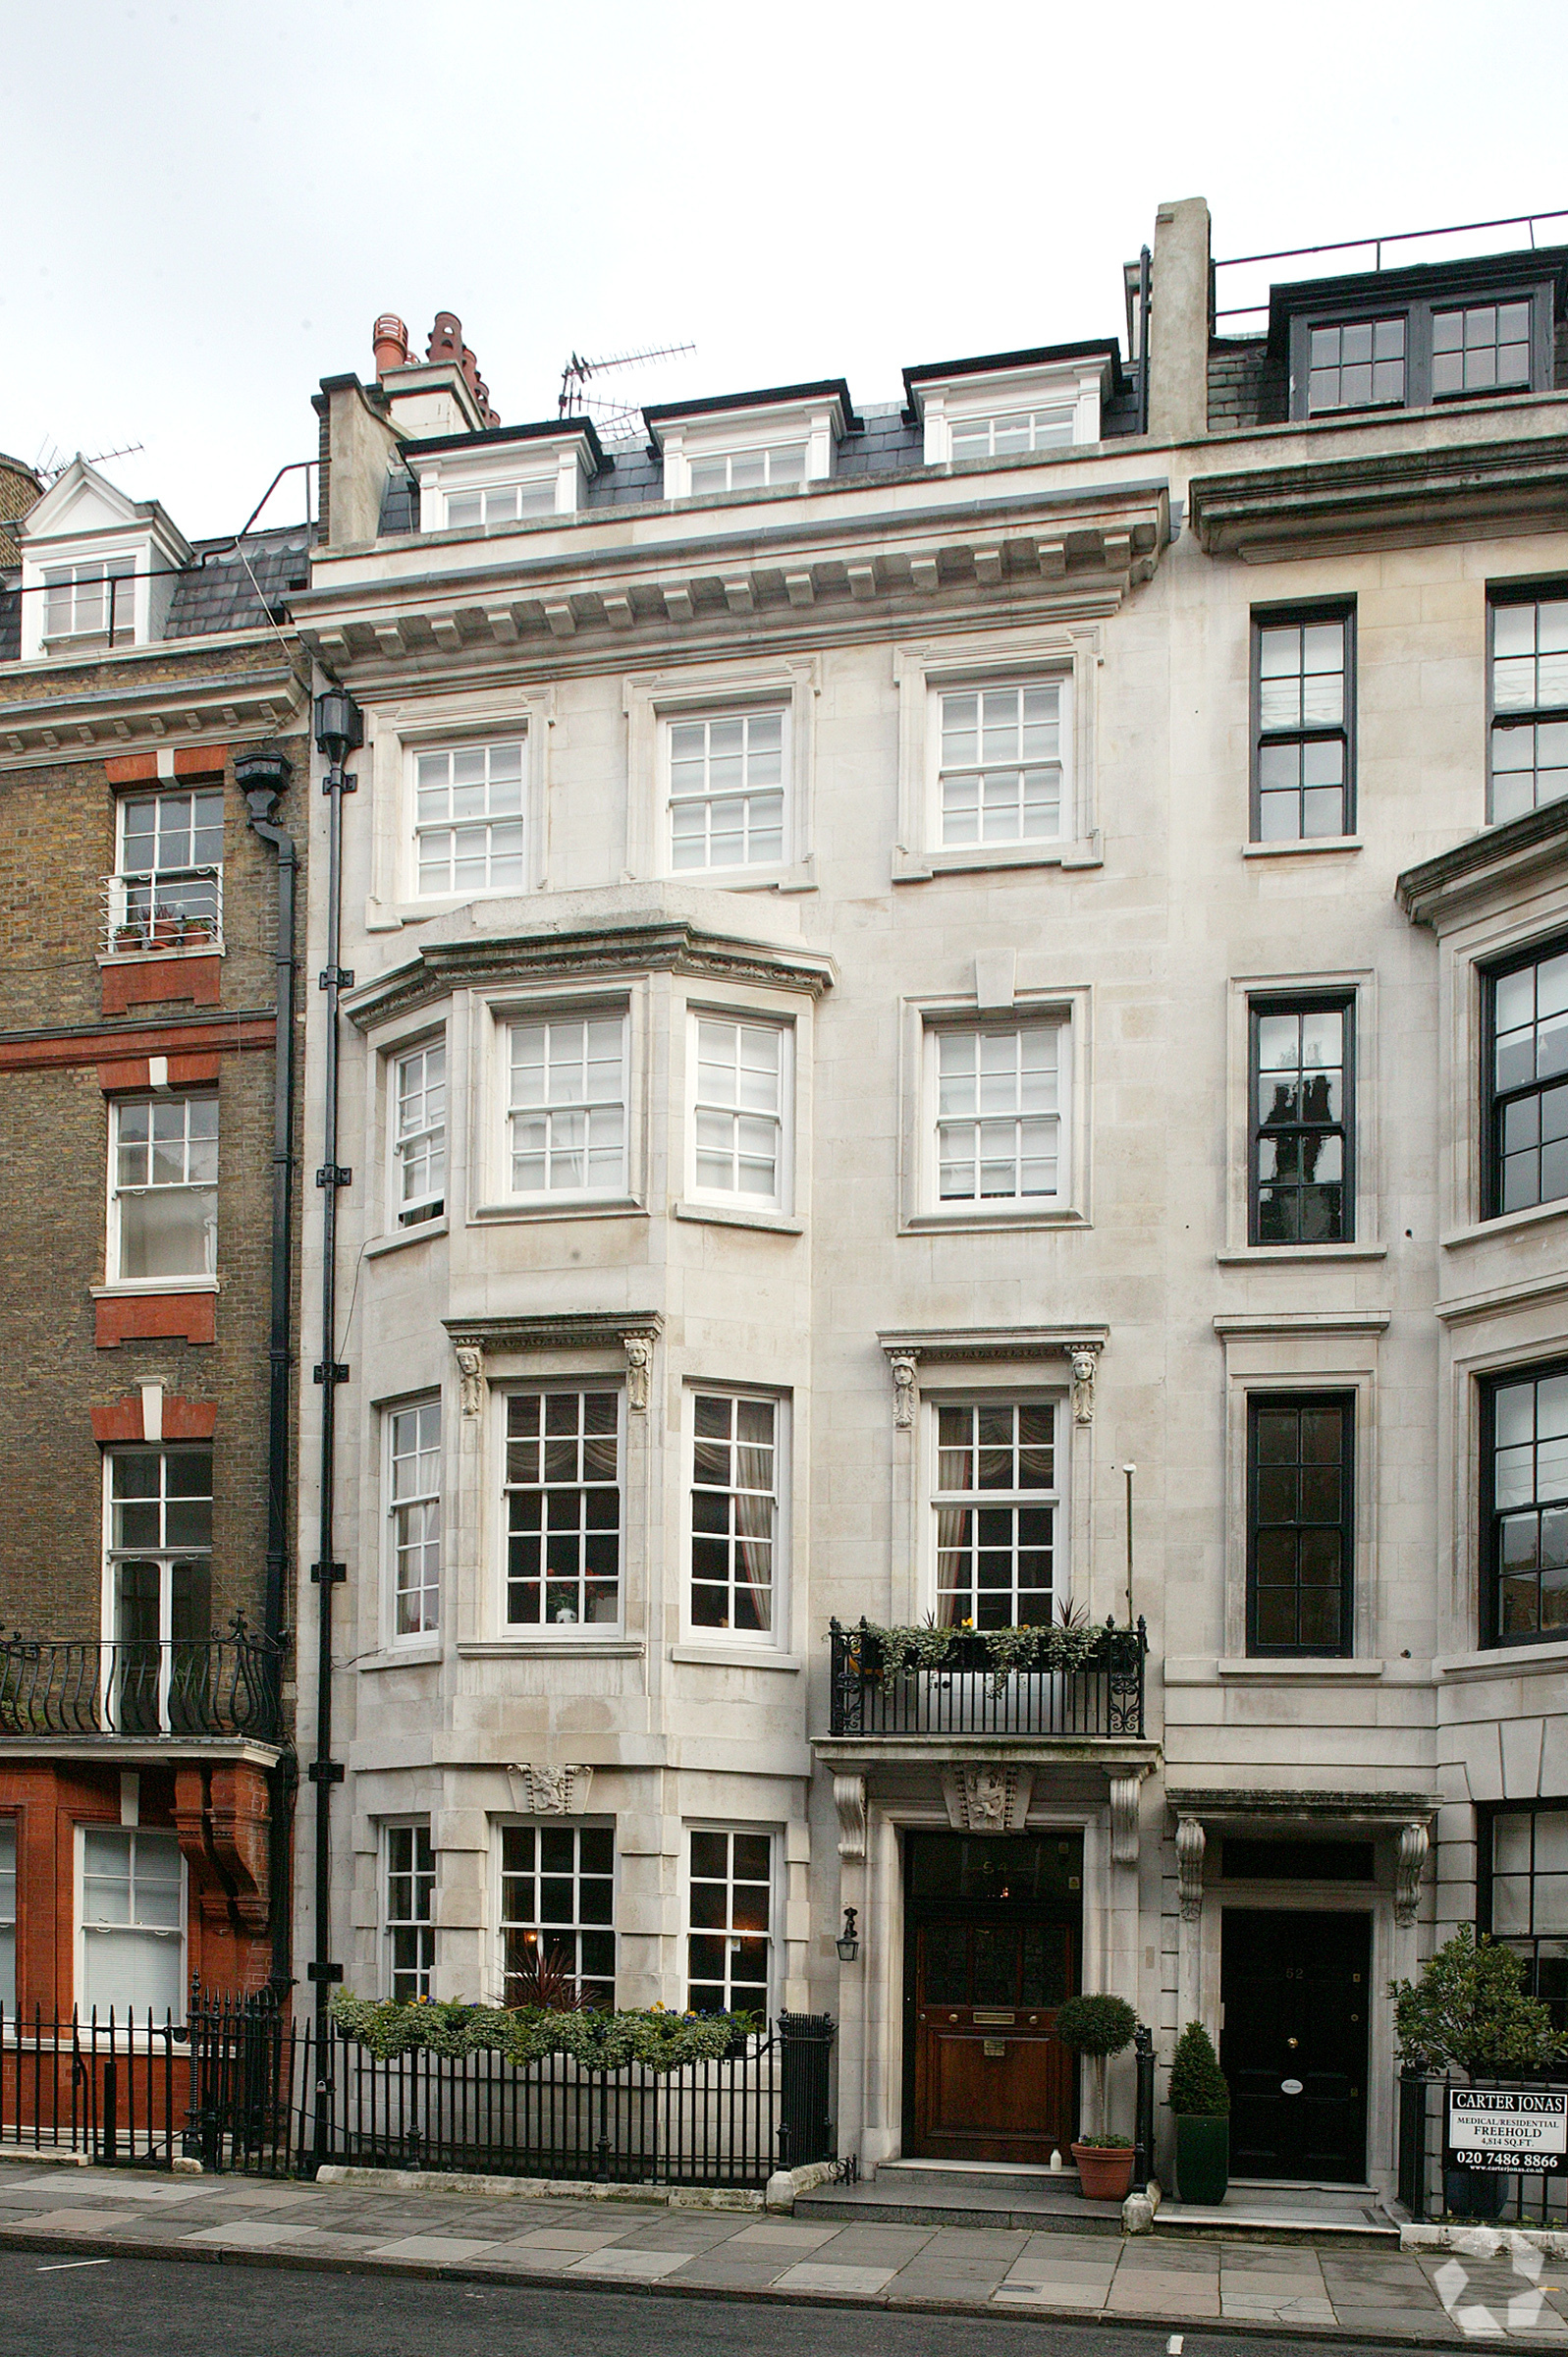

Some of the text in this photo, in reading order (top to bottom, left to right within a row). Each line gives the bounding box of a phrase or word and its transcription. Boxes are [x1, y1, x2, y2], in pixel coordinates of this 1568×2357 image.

[1457, 2094, 1563, 2112] CARTER JONAS
[1457, 2117, 1559, 2128] MEDICAL/RESIDENTIAL
[1474, 2126, 1542, 2138] FREEHOLD
[1481, 2137, 1534, 2147] 4,814 SQ.FT.
[1456, 2151, 1558, 2167] 020 7486 8866
[1470, 2165, 1544, 2173] www.carterjonas.co.uk
